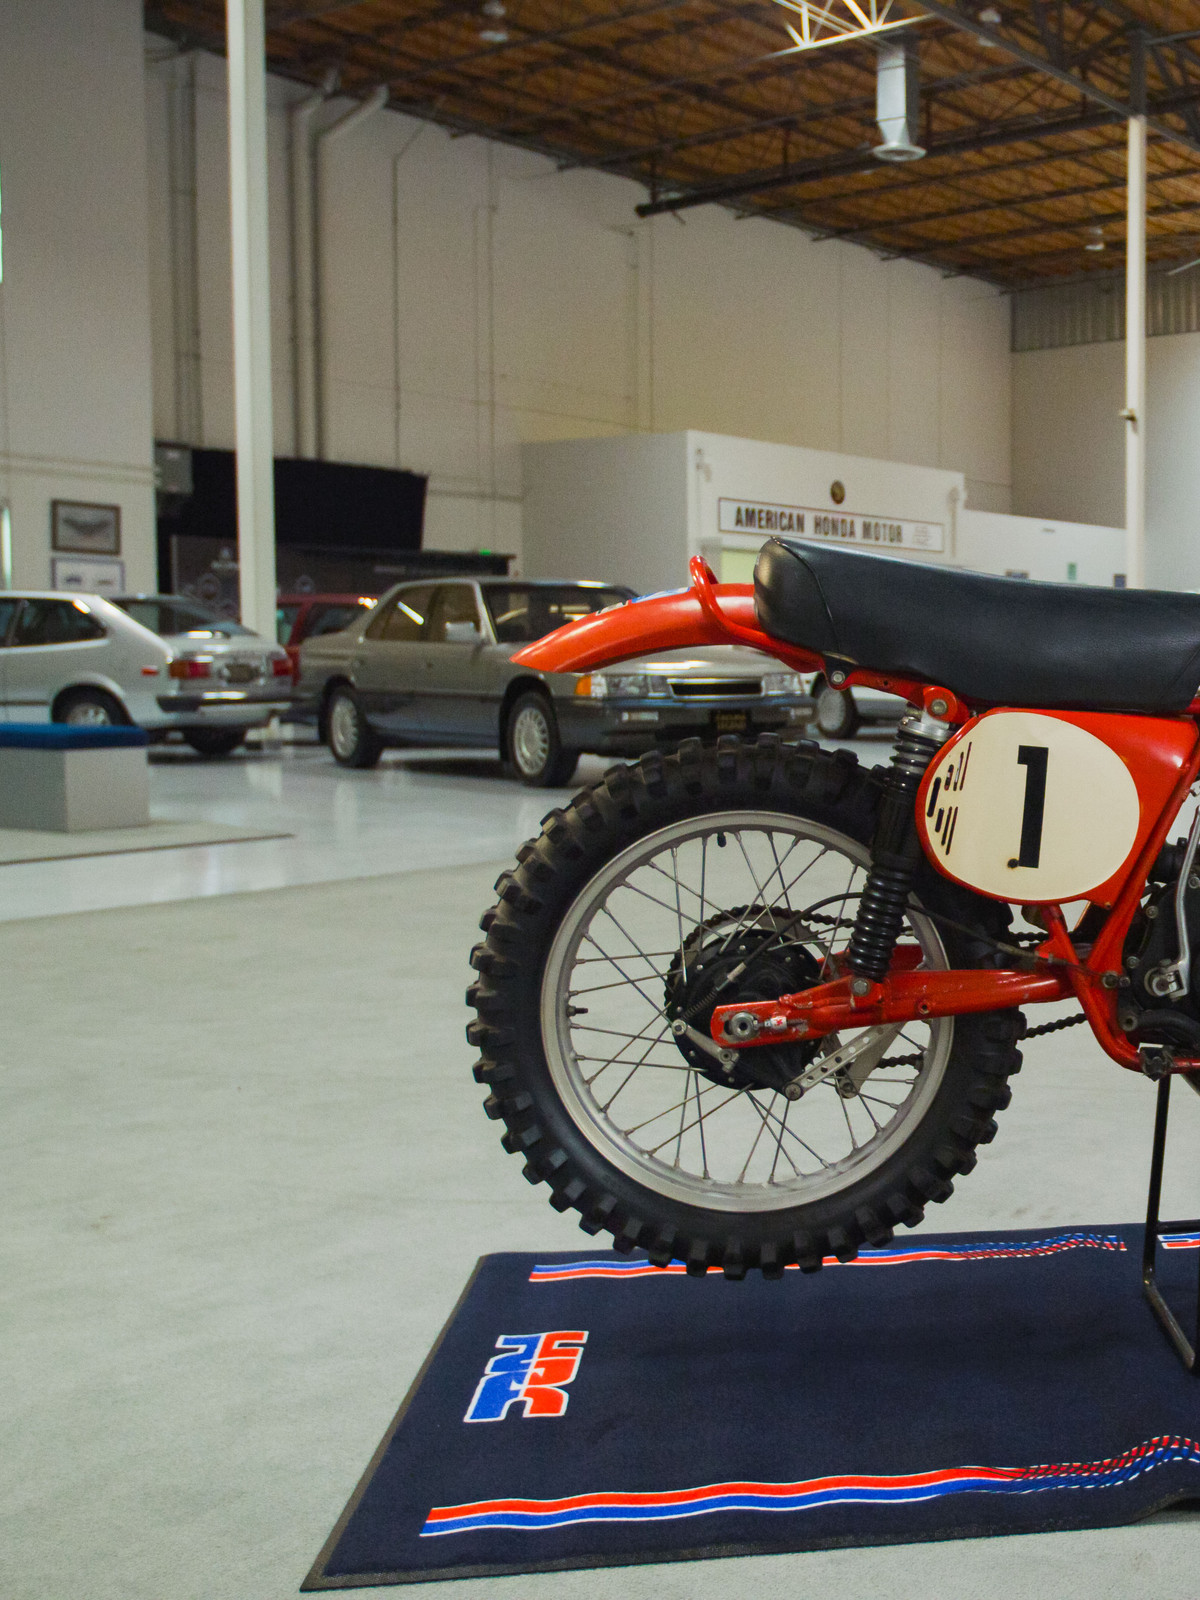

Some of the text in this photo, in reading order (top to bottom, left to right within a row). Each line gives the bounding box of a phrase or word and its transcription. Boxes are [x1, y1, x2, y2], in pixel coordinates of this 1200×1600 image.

[735, 506, 805, 533] AMERICAN
[814, 514, 856, 538] HONDA
[862, 520, 903, 543] MOTOR
[1017, 745, 1049, 869] 1
[463, 1330, 589, 1423] HRC
